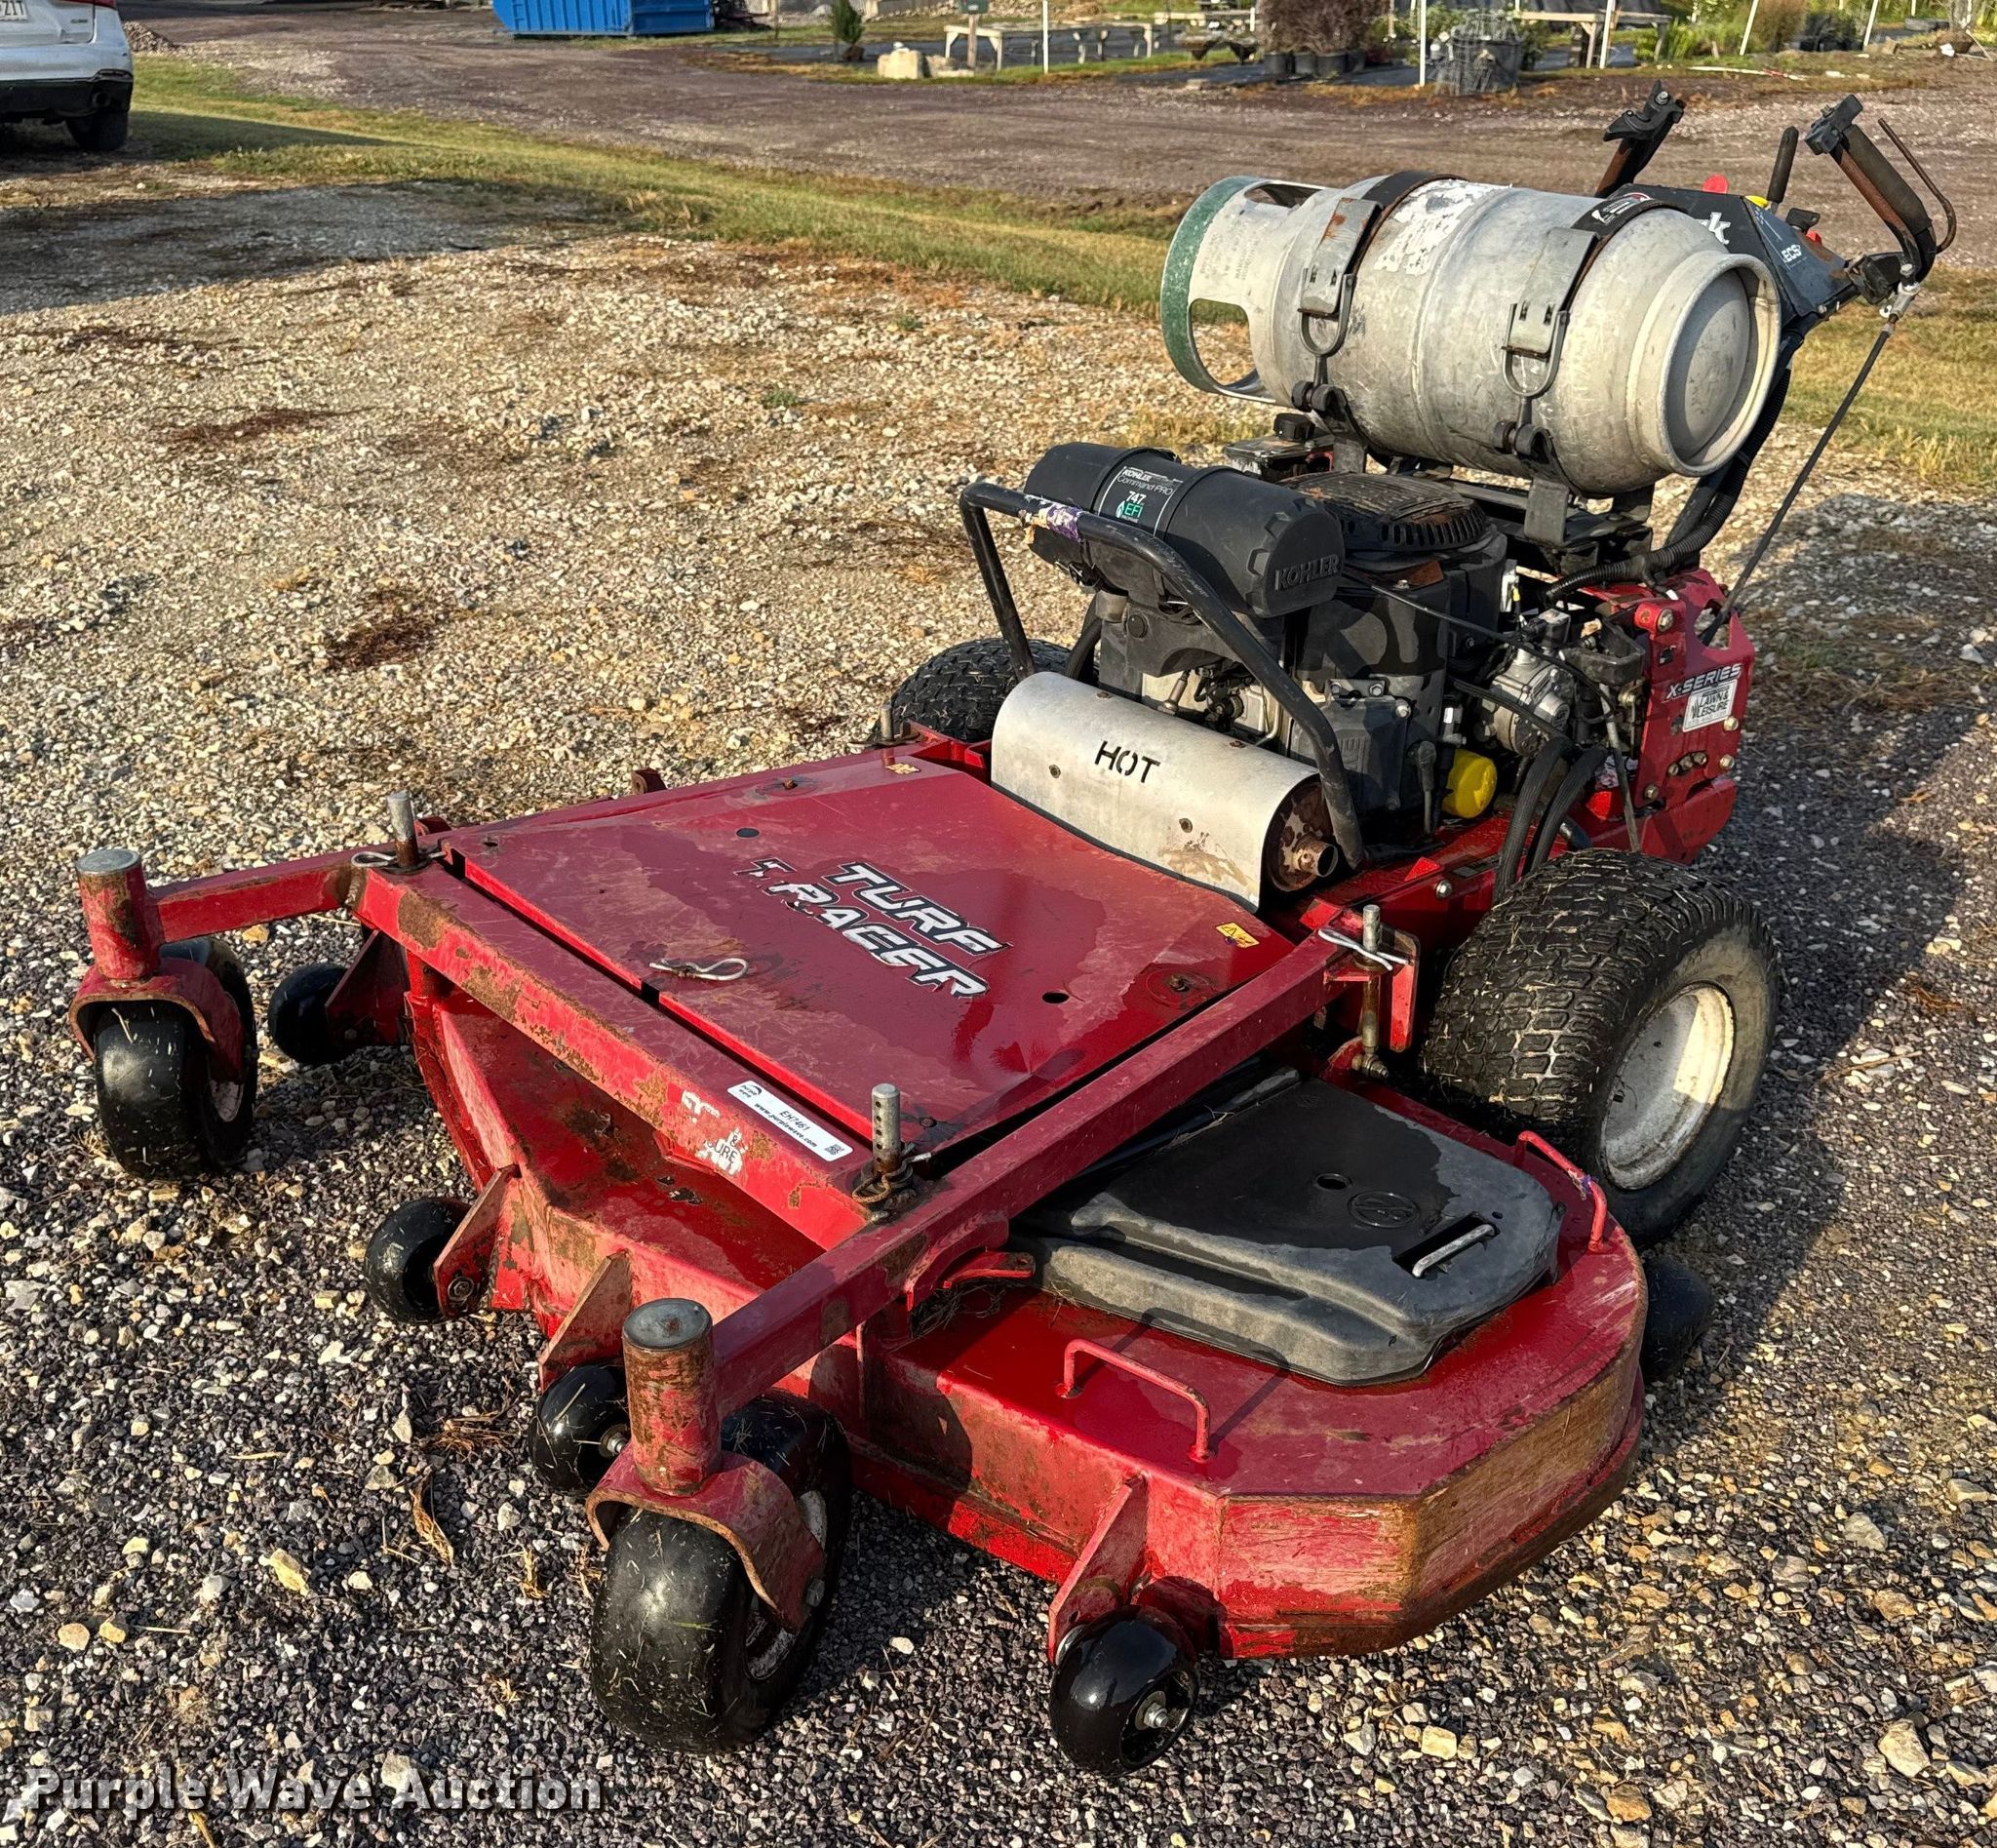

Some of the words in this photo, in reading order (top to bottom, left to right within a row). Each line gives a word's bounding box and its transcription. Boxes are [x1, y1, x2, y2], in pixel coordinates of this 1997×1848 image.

[0, 0, 23, 16] Z1T
[1116, 475, 1155, 491] Command
[1154, 485, 1173, 495] PRO
[1126, 491, 1147, 504] 747
[1124, 503, 1143, 518] EFI
[1274, 553, 1340, 591] KOHLER
[1094, 740, 1161, 784] HOT
[822, 862, 1010, 956] TURF
[755, 1103, 818, 1148] www.purplewave.com
[779, 1110, 811, 1131] EH7461
